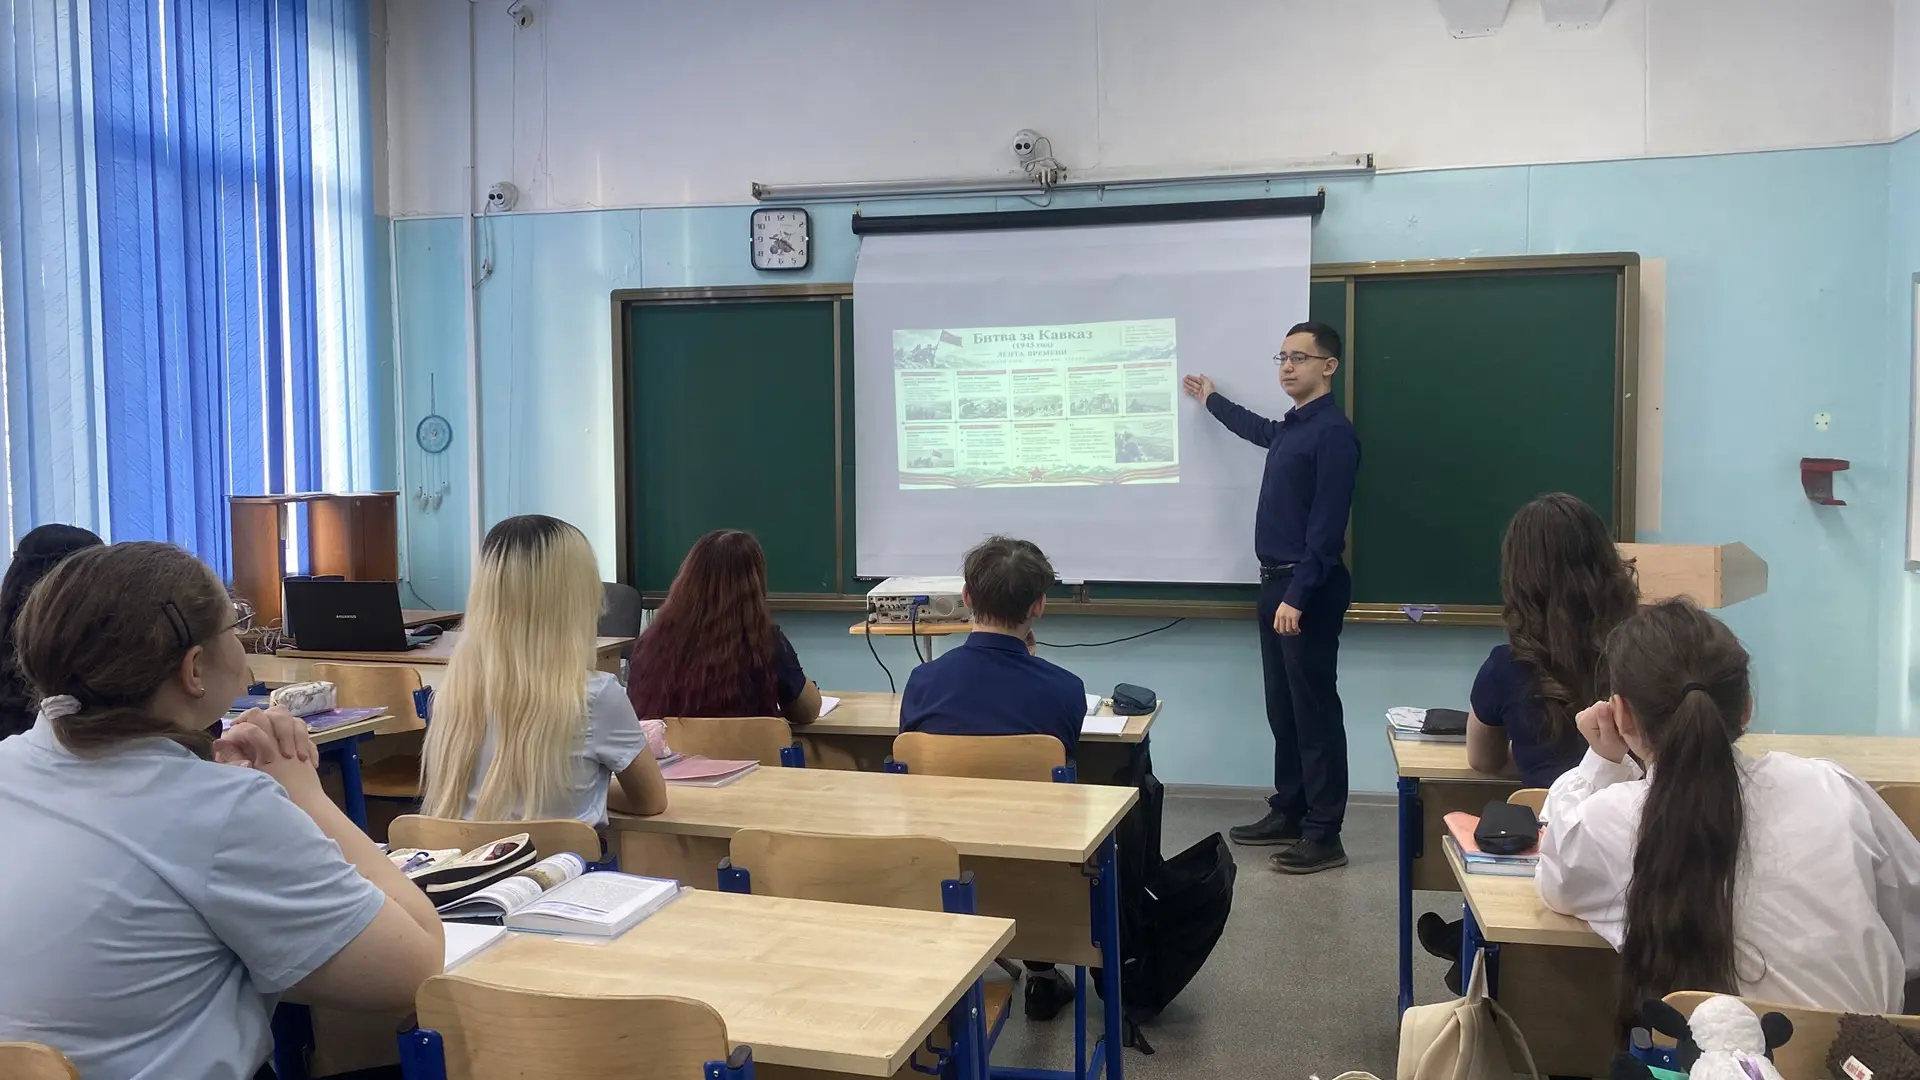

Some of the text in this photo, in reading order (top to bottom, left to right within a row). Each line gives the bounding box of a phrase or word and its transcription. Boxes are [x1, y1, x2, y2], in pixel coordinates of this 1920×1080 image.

[972, 329, 1093, 344] Битва за Кавказ
[1027, 349, 1067, 357] ВРЕМЕНИ
